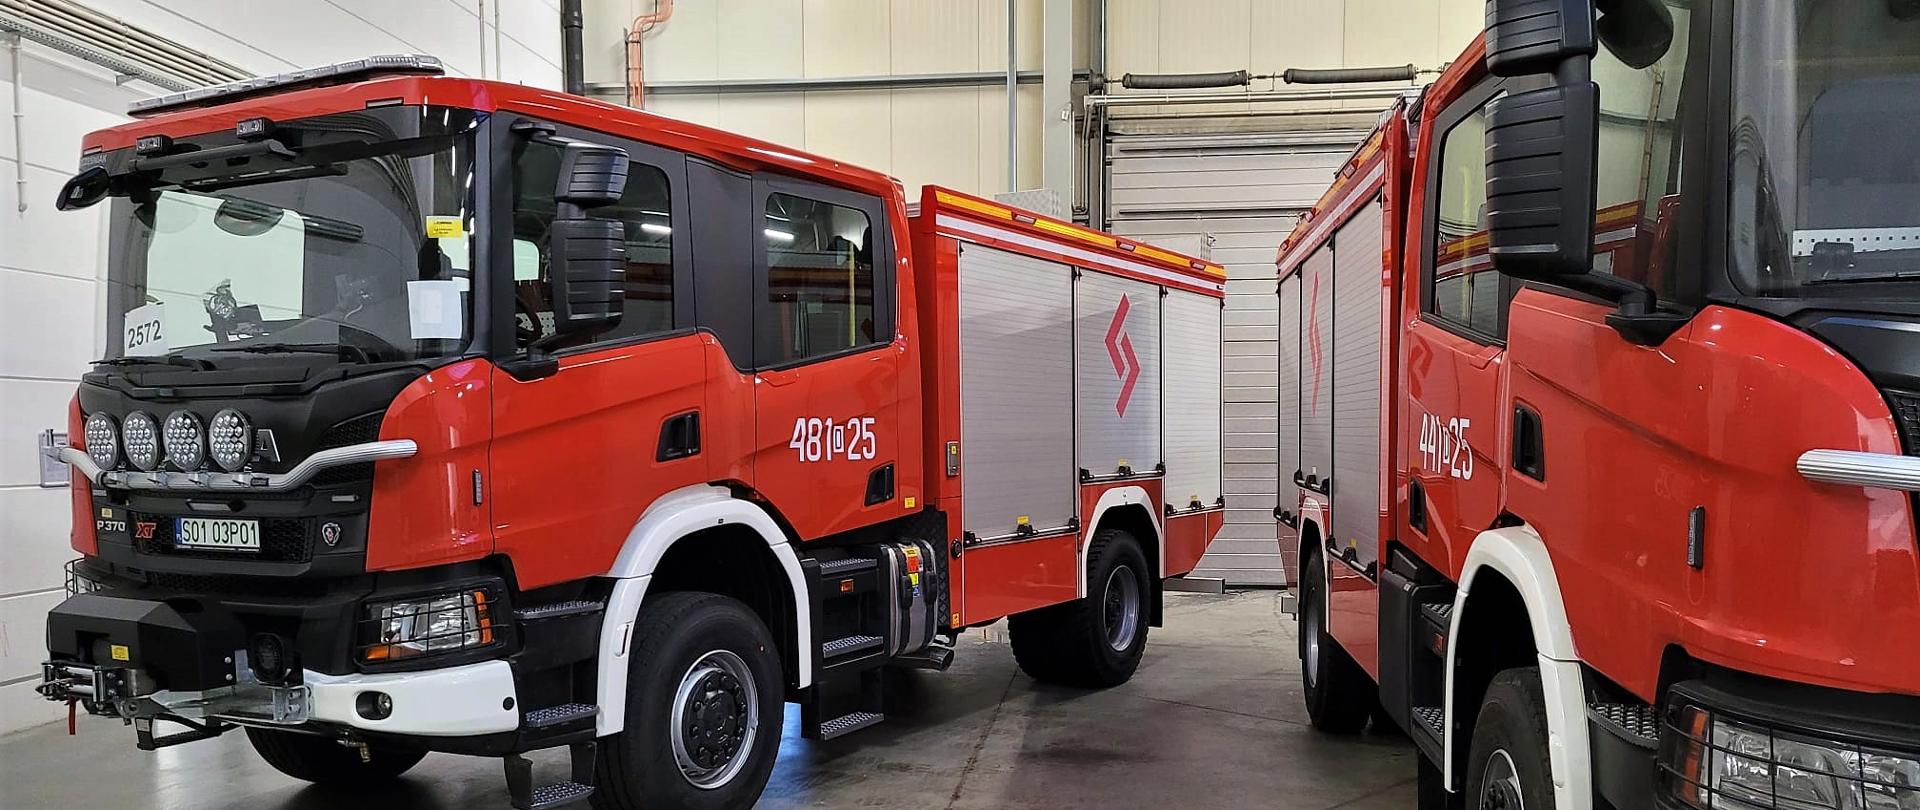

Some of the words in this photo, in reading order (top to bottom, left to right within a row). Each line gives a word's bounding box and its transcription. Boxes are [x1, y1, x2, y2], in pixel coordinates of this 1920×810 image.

[128, 320, 162, 348] 2572
[104, 521, 126, 532] 370
[135, 522, 157, 539] XT
